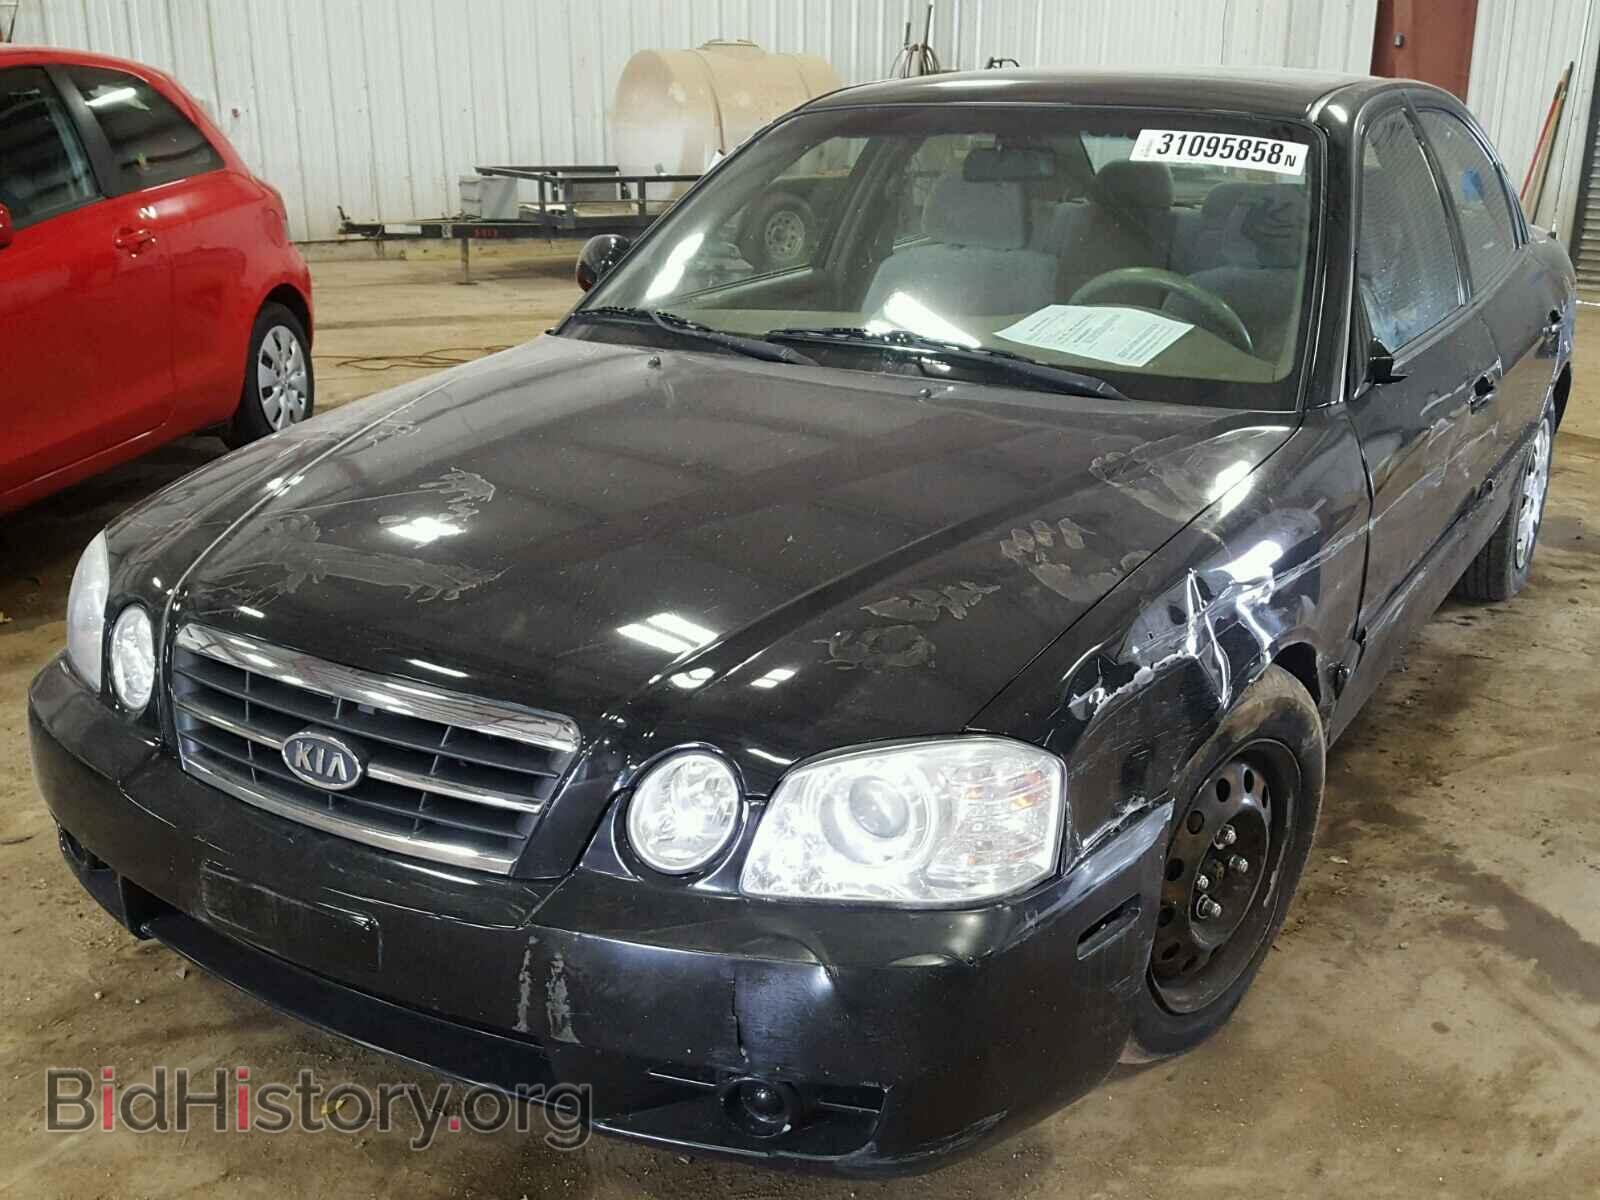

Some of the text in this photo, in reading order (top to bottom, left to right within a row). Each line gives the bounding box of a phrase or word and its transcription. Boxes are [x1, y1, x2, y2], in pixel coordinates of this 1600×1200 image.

[1156, 133, 1284, 165] 31095858
[1284, 154, 1297, 168] N
[295, 740, 347, 781] KIA
